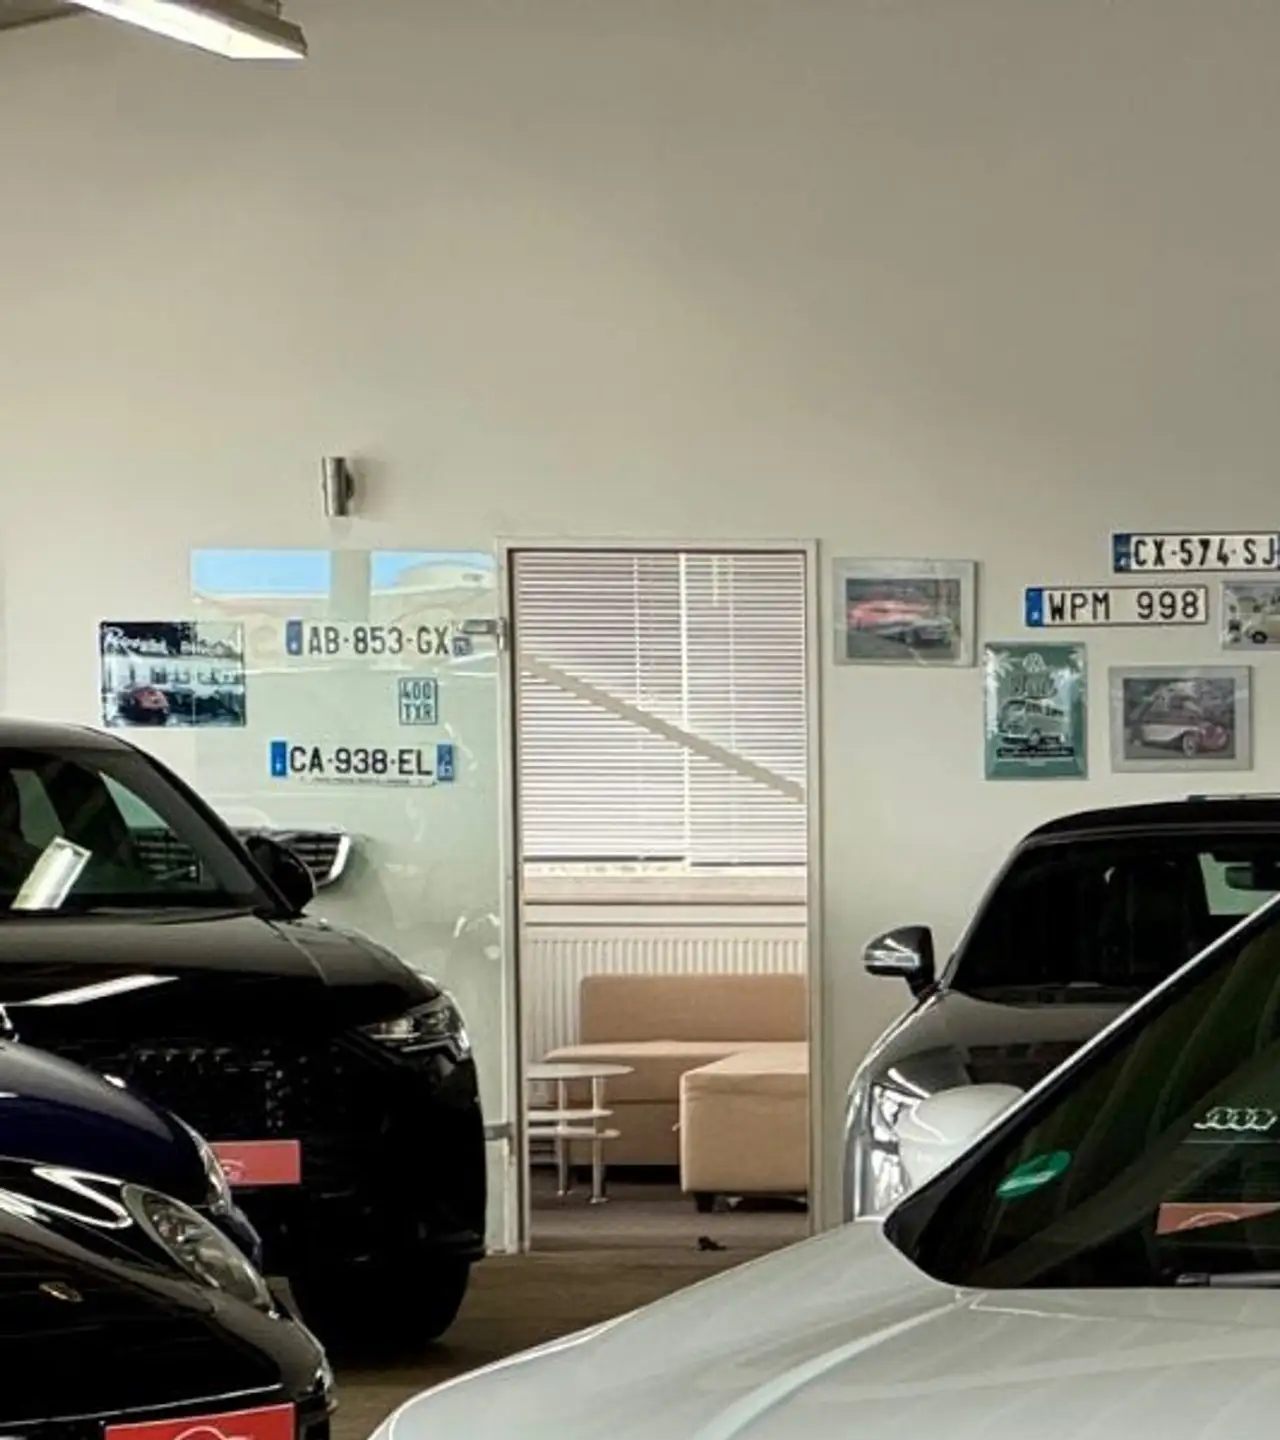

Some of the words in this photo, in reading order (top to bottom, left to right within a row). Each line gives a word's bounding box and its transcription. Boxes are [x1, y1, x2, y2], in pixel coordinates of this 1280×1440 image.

[1133, 537, 1276, 566] CX-574-SJ
[1048, 593, 1111, 622] WPM
[1136, 590, 1200, 620] 998
[308, 625, 449, 656] AB-853-GX
[290, 745, 434, 776] CA-938-EL
